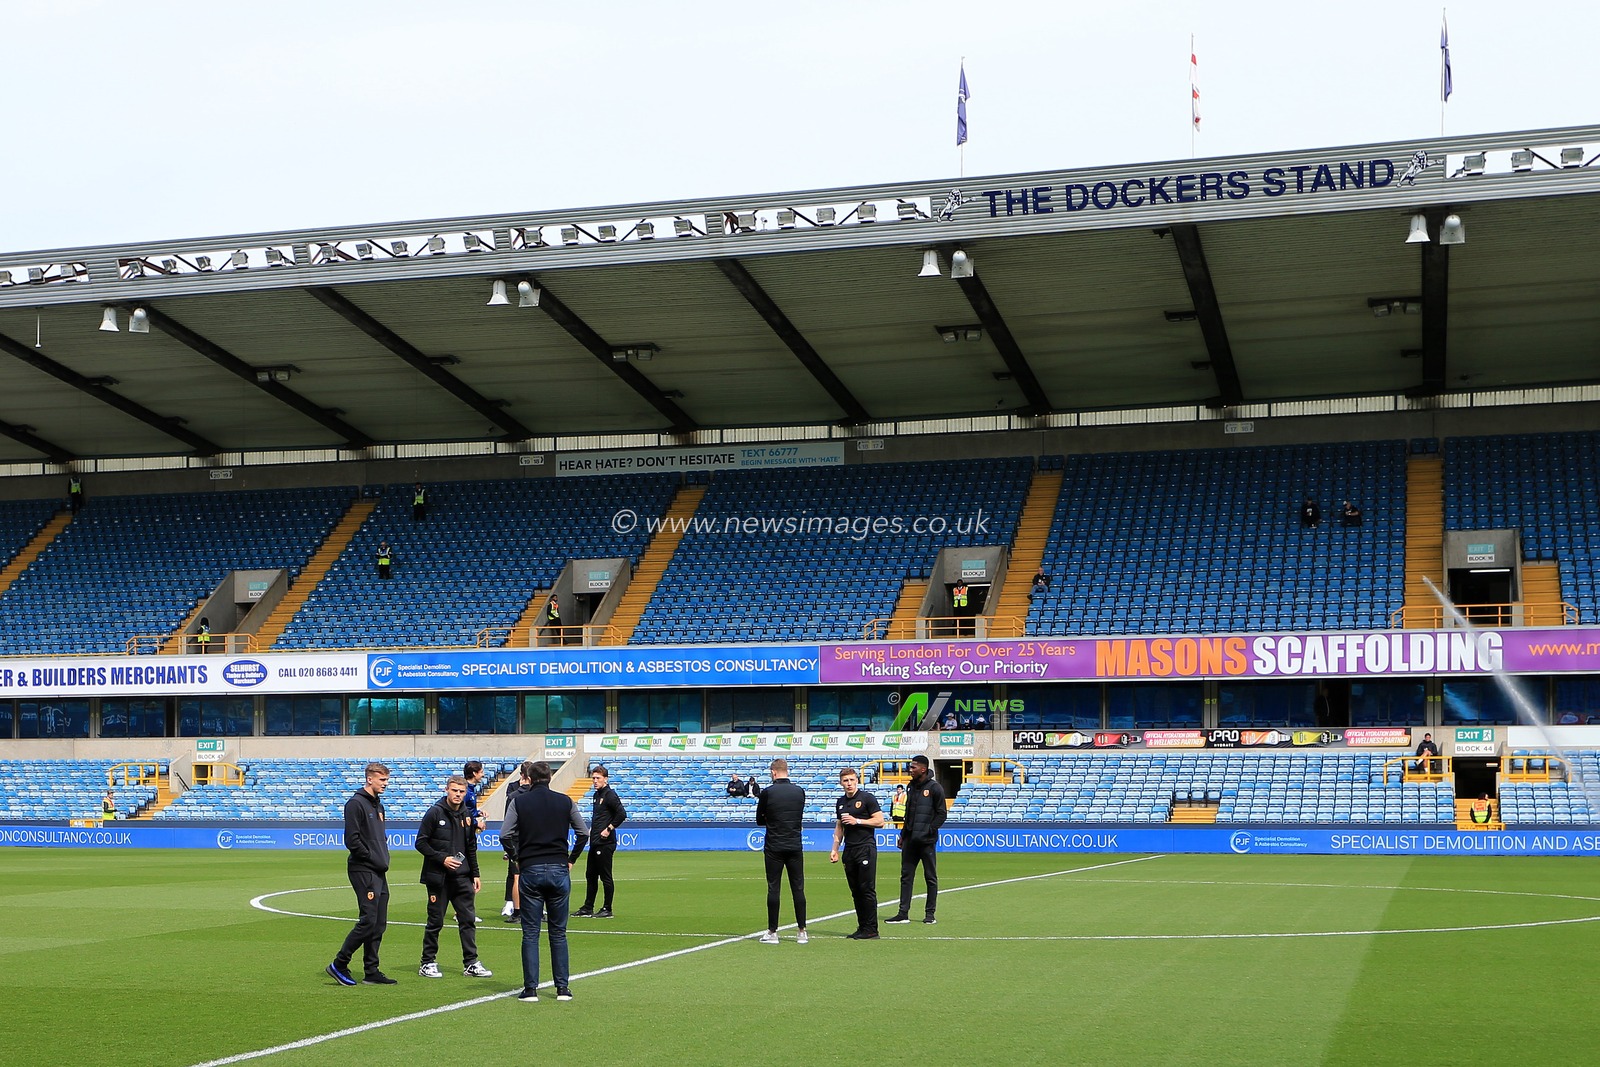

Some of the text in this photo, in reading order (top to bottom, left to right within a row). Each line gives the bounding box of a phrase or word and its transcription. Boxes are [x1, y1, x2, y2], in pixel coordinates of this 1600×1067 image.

[981, 159, 1395, 217] THE DOCKERS STAND
[741, 447, 798, 458] TEXT 66777
[560, 454, 735, 471] HEAR HATE? DON'T HESITATE
[763, 458, 797, 466] MESSAGE
[835, 643, 1075, 662] Serving London For Over 25 Years
[1096, 631, 1503, 676] MASONS SCAFFOLDING
[230, 664, 260, 673] SELHURST
[278, 666, 357, 677] CALL 020 8683 4411
[376, 668, 392, 676] PJF
[462, 658, 817, 676] SPECIALIST DEMOLITION & ASBESTOS CONSULTANCY
[862, 660, 1048, 679] Making Safety Our Priority
[18, 665, 208, 686] & BUILDERS MERCHANTS
[294, 834, 344, 845] SPECIALI
[1331, 836, 1418, 850] SPECIALIST
[1424, 836, 1527, 850] DEMOLITION
[1531, 836, 1567, 851] AND
